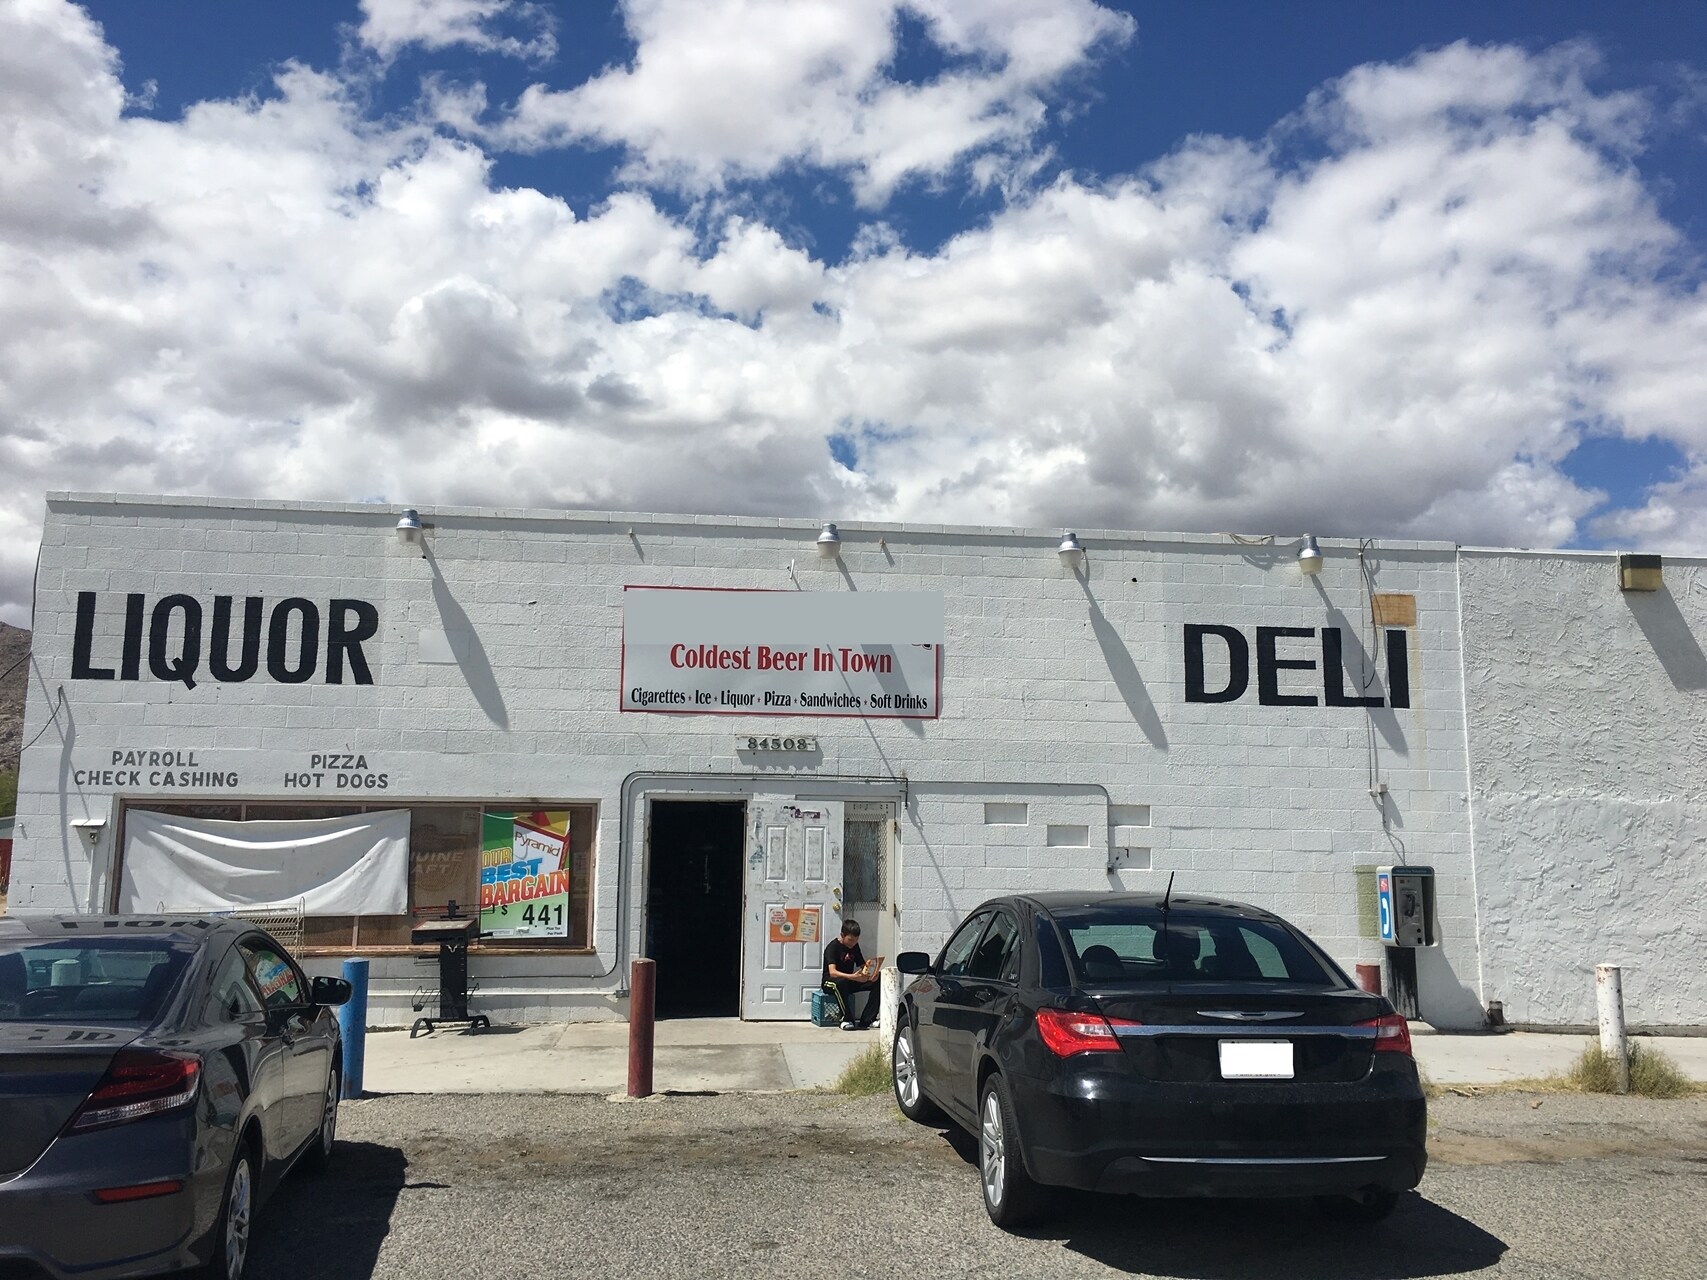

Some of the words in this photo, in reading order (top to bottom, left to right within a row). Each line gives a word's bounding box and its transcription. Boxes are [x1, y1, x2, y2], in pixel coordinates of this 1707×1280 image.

[71, 591, 379, 691] LIQUOR
[669, 643, 751, 670] Coldest
[757, 646, 808, 671] Beer
[813, 648, 833, 672] In
[838, 648, 892, 673] Town
[1183, 623, 1410, 709] DELI
[631, 687, 686, 707] Cigarettes
[695, 689, 712, 705] Ice
[720, 689, 756, 708] Liquor
[764, 690, 792, 707] Pizza
[799, 691, 861, 708] Sandwiches
[870, 693, 892, 709] Soft
[894, 693, 928, 710] Drinks
[747, 737, 807, 750] 84508
[111, 751, 199, 767] PAYROLL
[311, 755, 368, 770] PIZZA
[74, 770, 140, 787] CHECK
[149, 771, 239, 788] CASHING
[284, 773, 324, 789] HOT
[337, 773, 389, 790] DOGS
[514, 831, 561, 857] Pyramid
[481, 848, 513, 868] OUR
[481, 858, 543, 885] BEST
[481, 869, 570, 910] BARGAIN
